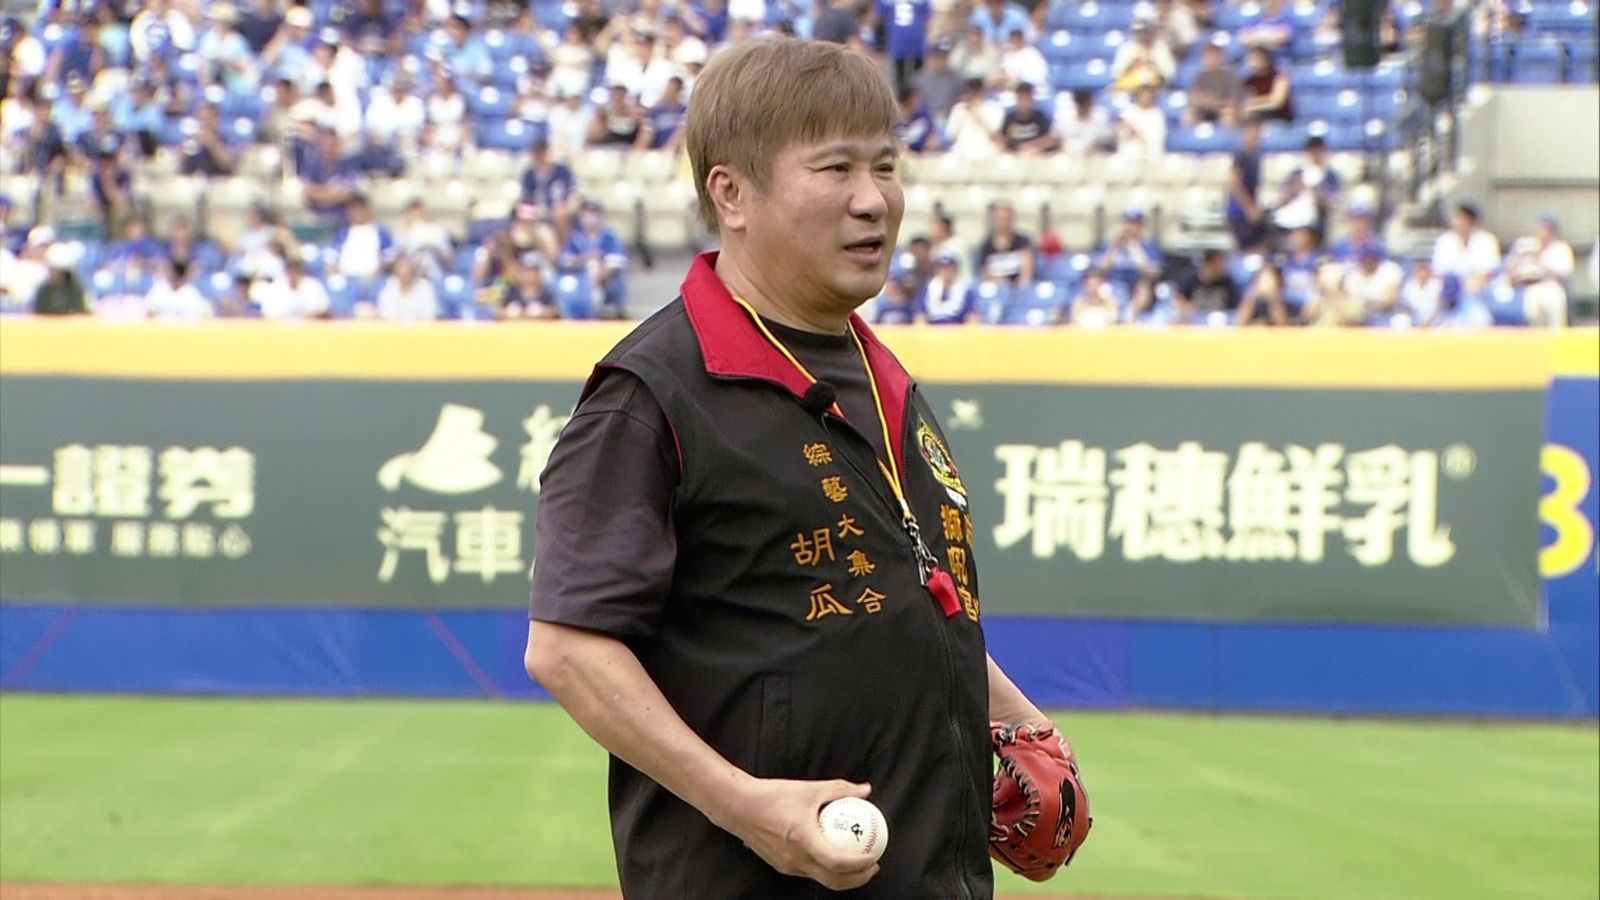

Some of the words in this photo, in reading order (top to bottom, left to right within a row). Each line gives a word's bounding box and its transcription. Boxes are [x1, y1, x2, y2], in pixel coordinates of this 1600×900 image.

[376, 505, 536, 583] 汽車
[803, 442, 886, 614] 綜藝大集合
[992, 440, 1457, 568] 瑞穗鮮乳
[790, 527, 853, 621] 胡瓜
